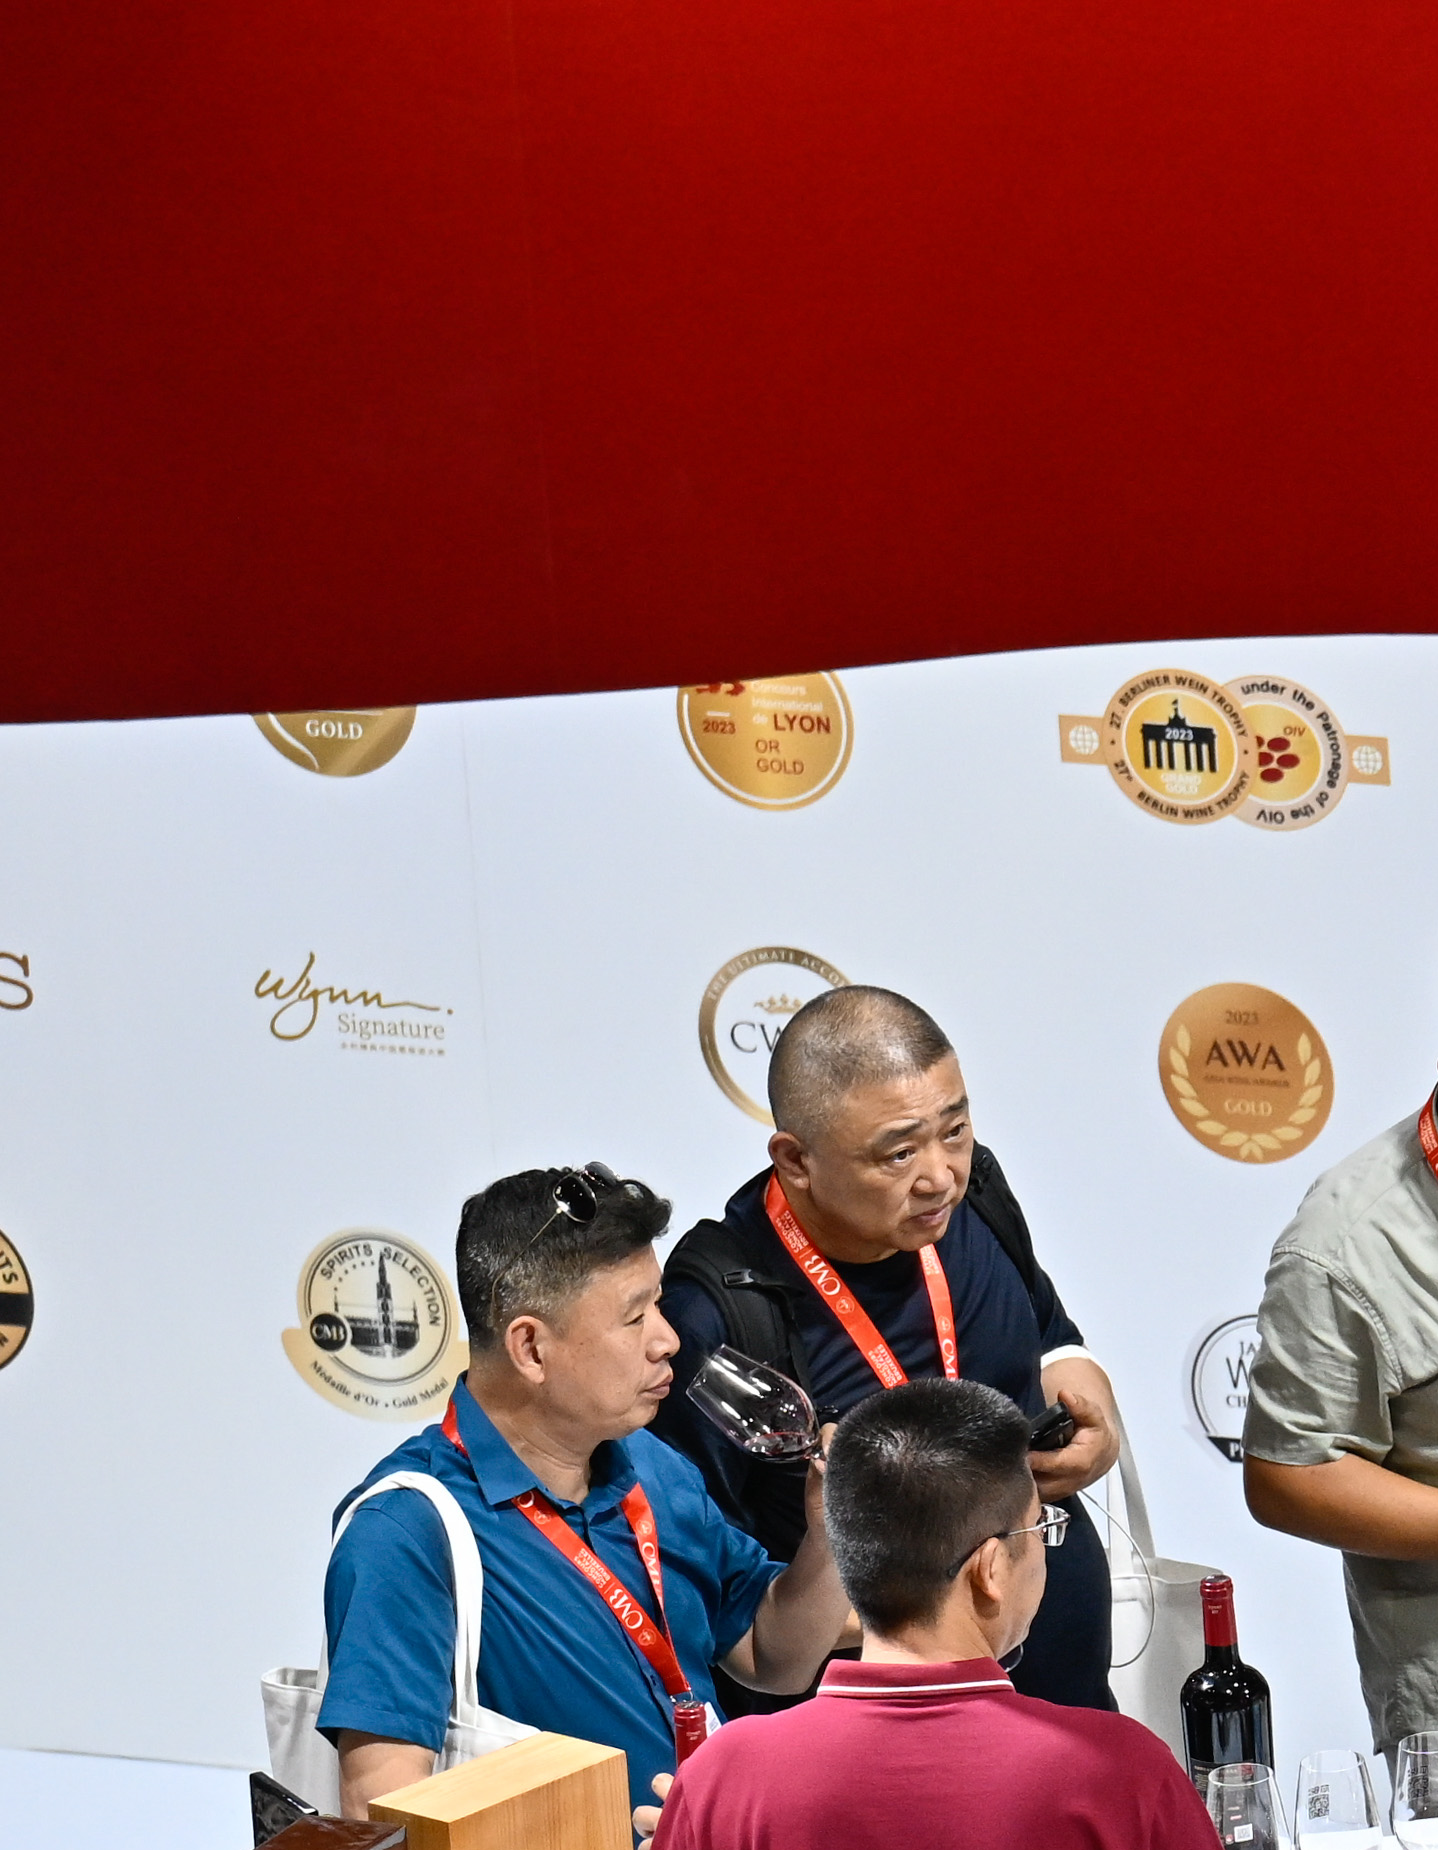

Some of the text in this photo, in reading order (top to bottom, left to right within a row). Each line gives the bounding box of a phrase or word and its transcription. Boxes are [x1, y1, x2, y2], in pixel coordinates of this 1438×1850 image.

[1241, 681, 1287, 695] under
[1119, 674, 1170, 706] BERLINER
[1174, 675, 1208, 695] WEIN
[1212, 691, 1248, 738] TROPHY
[1292, 689, 1316, 712] the
[306, 720, 363, 740] GOLD
[703, 719, 736, 735] 2023
[774, 713, 831, 734] LYON
[1283, 726, 1308, 738] OIV
[1164, 728, 1194, 742] 2023
[755, 739, 780, 754] OR
[1316, 711, 1342, 789] Patronage
[757, 759, 804, 775] GOLD
[1137, 791, 1178, 818] BERLIN
[1182, 806, 1216, 819] WINE
[1217, 773, 1250, 812] TROPHY
[1315, 791, 1330, 809] of
[1290, 808, 1316, 820] the
[338, 1013, 445, 1040] Signature
[1225, 1010, 1260, 1026] 2023
[1205, 1039, 1286, 1072] AWA
[1224, 1100, 1273, 1117] GOLD
[320, 1243, 441, 1327] SPIRITS SELECTION
[804, 1255, 841, 1295] CMB
[609, 1588, 643, 1629] CMB
